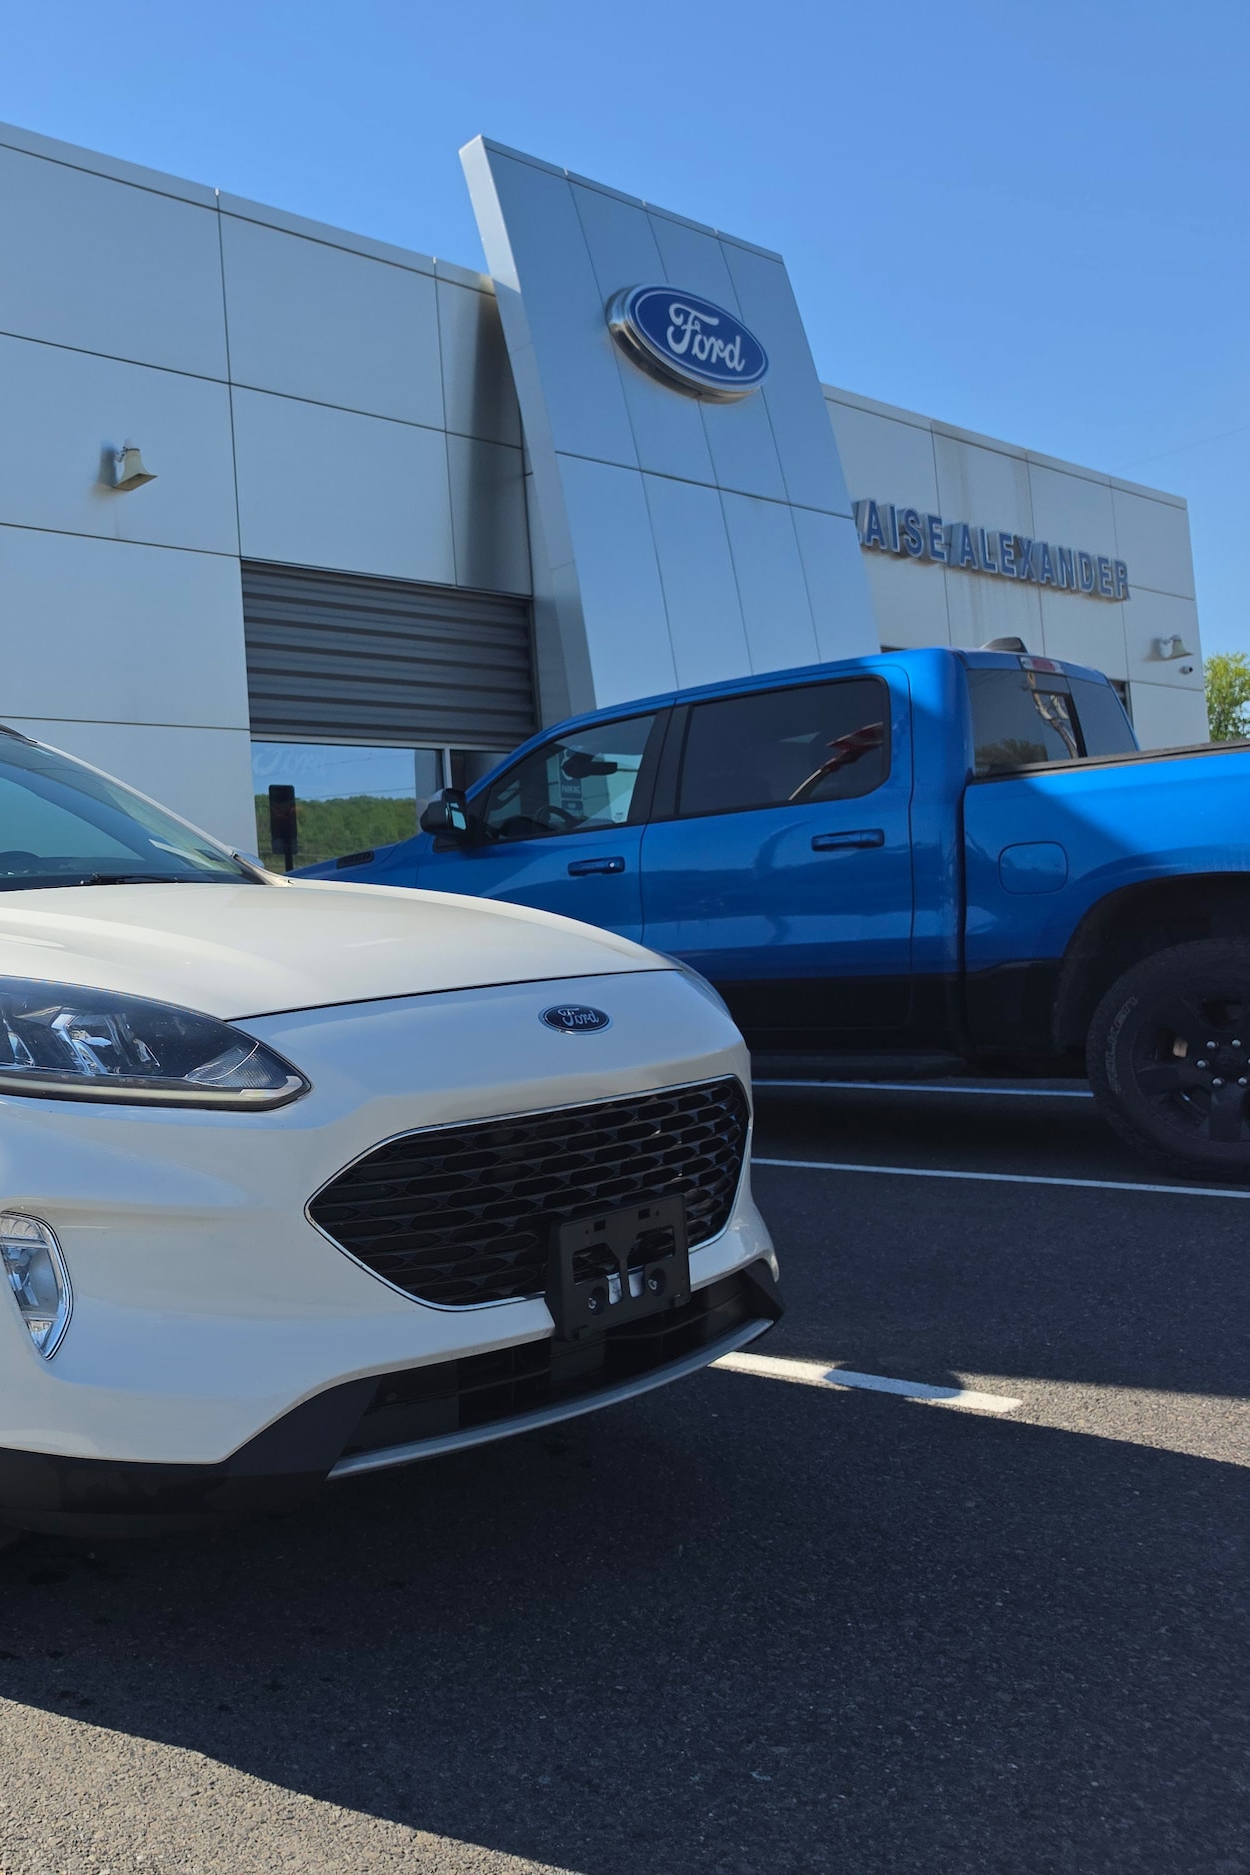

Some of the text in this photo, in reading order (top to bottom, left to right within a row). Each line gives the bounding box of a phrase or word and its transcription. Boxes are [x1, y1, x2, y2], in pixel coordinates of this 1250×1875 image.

[667, 303, 745, 372] Ford
[952, 523, 1130, 600] ALEXANDER
[557, 1007, 600, 1027] Ford
